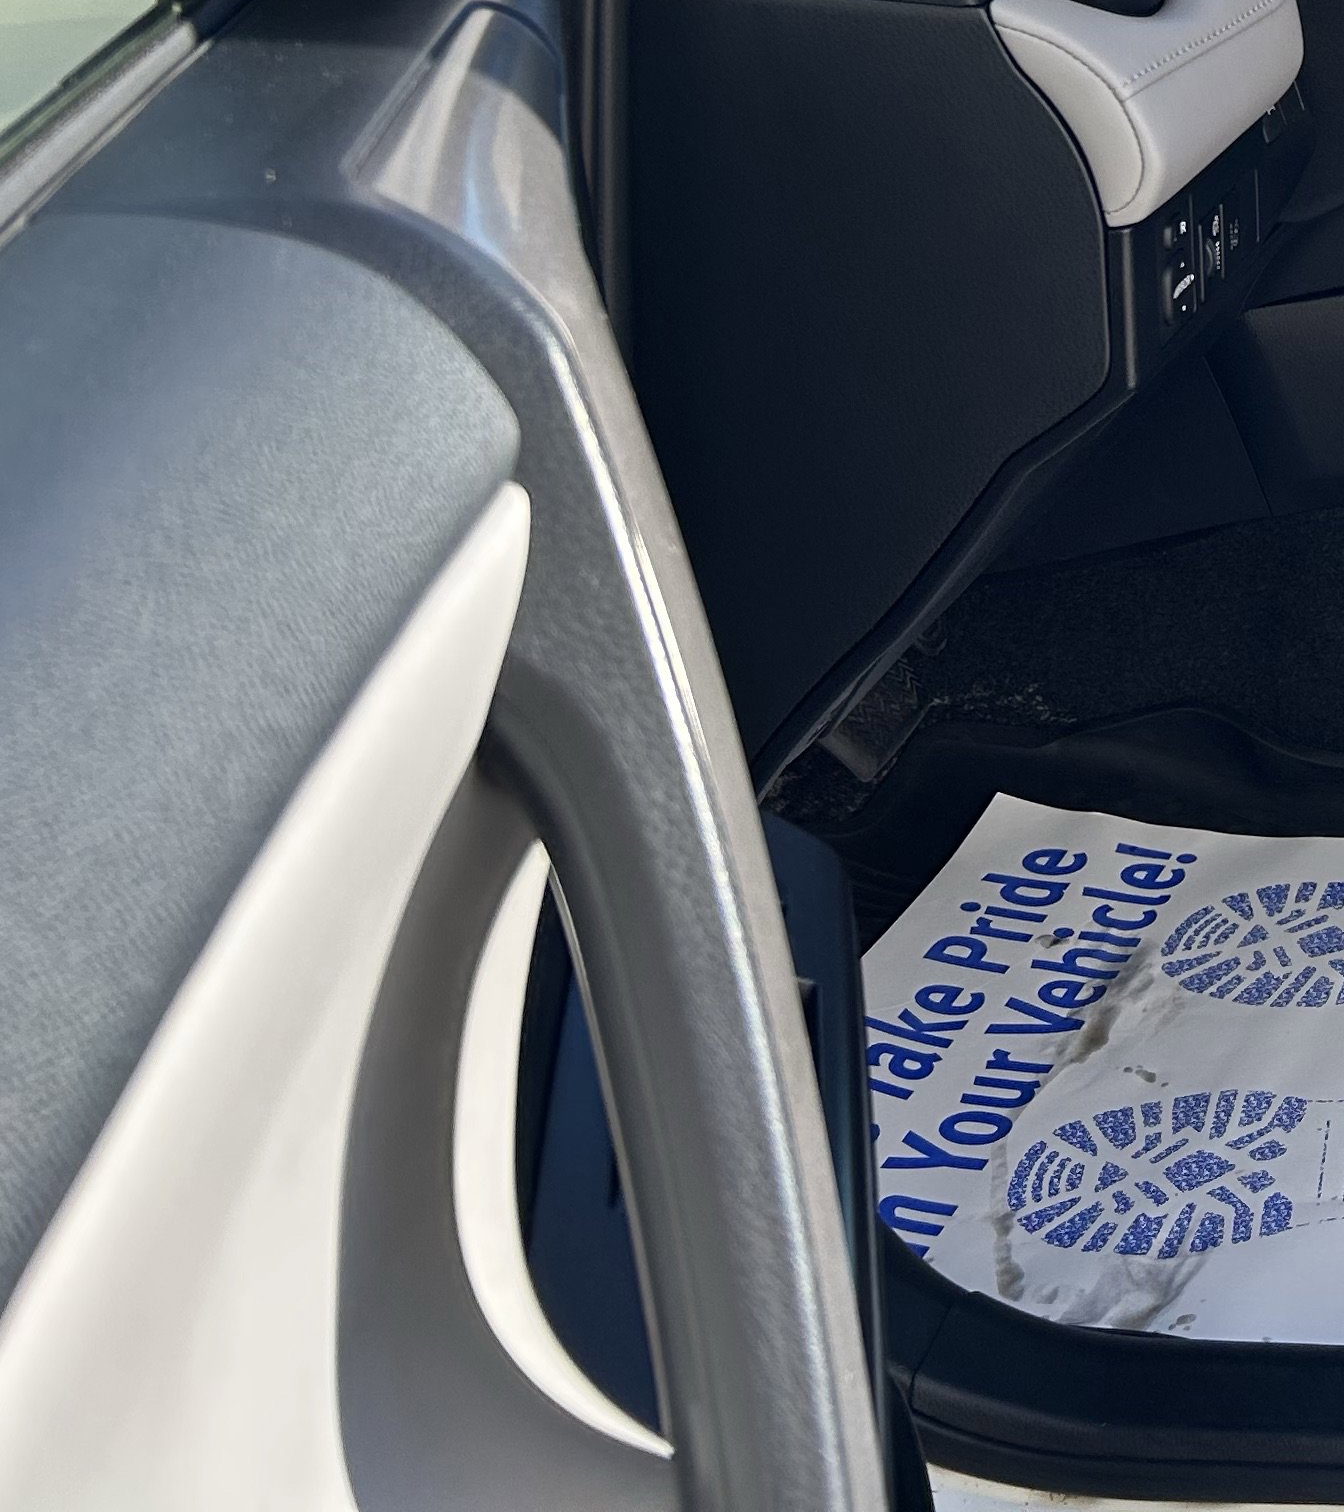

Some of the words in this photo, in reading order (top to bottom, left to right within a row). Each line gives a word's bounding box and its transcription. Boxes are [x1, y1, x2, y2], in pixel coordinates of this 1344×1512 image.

[879, 1047, 1054, 1171] Your
[984, 841, 1198, 1036] Vehicle!
[922, 848, 1088, 975] Pride
